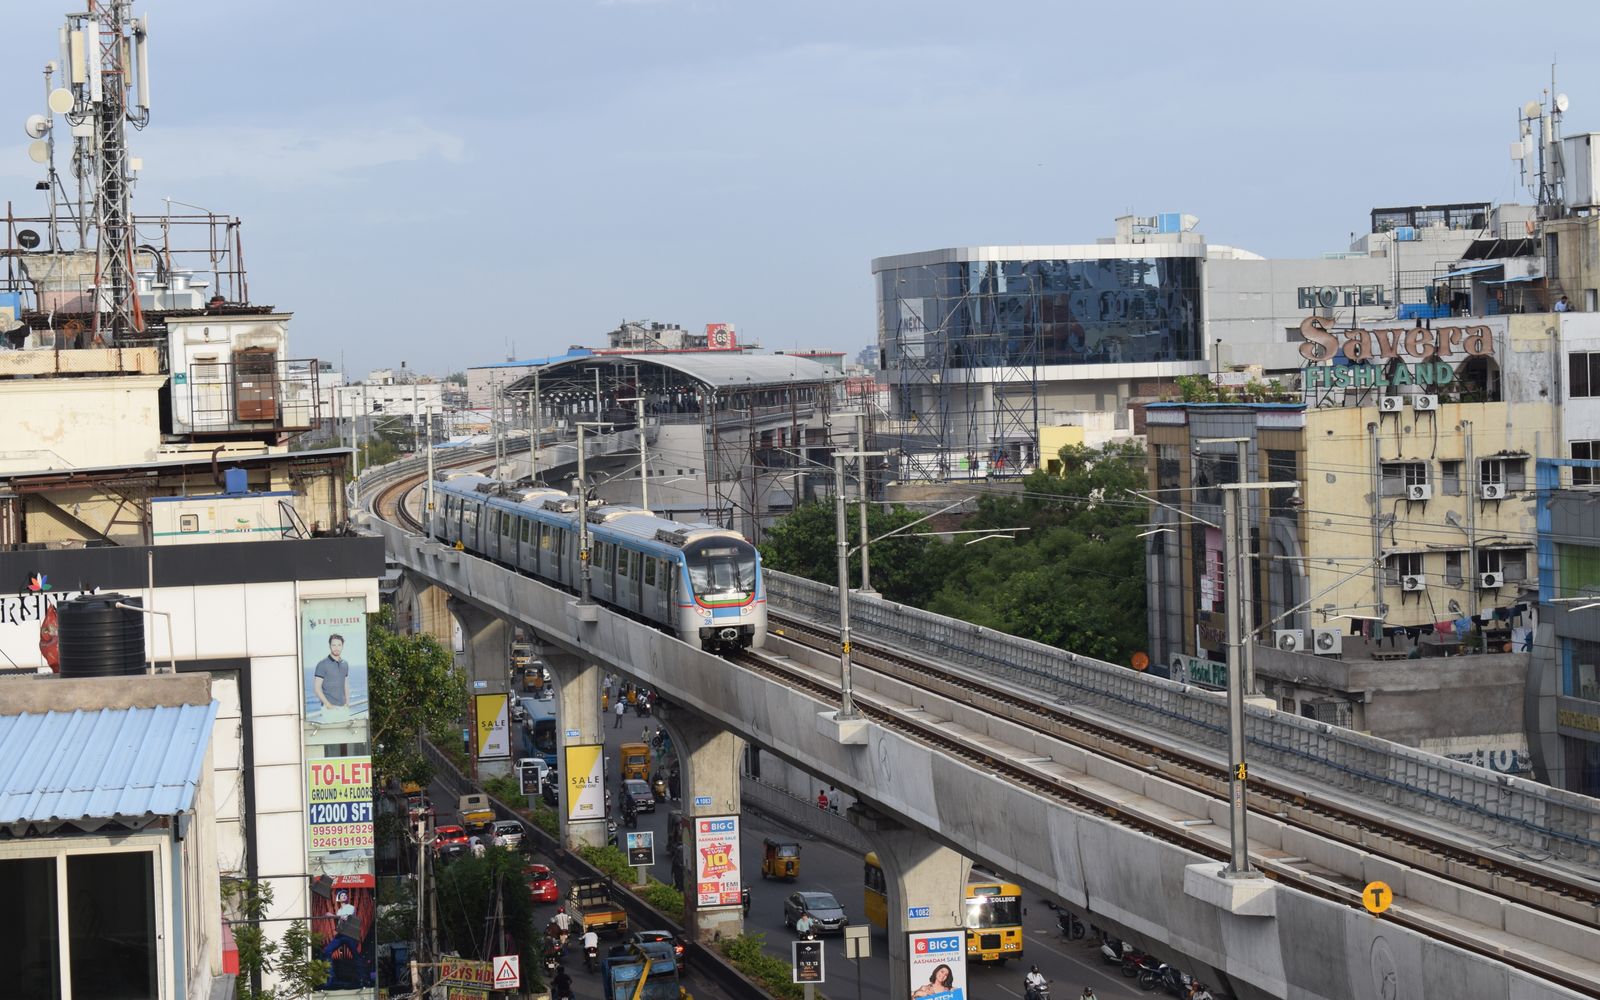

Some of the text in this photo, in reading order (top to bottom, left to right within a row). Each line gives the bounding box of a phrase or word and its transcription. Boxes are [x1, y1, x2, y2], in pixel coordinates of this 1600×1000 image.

[1298, 285, 1391, 308] HOTEL
[1299, 316, 1495, 361] Savera
[1306, 361, 1454, 389] FISHLAND
[481, 720, 506, 728] SALE
[311, 763, 371, 786] TO-LET
[571, 776, 600, 785] SALE
[312, 788, 337, 800] GROUND
[344, 788, 348, 799] 4
[350, 786, 373, 799] FLOORS
[311, 802, 373, 823] 12000 SFT
[313, 824, 373, 835] 9959912929
[711, 822, 726, 830] BIG
[313, 836, 373, 848] 9246191934
[707, 853, 727, 867] 10
[1370, 888, 1384, 908] T
[929, 940, 958, 950] BIG C
[442, 965, 472, 980] BOYS
